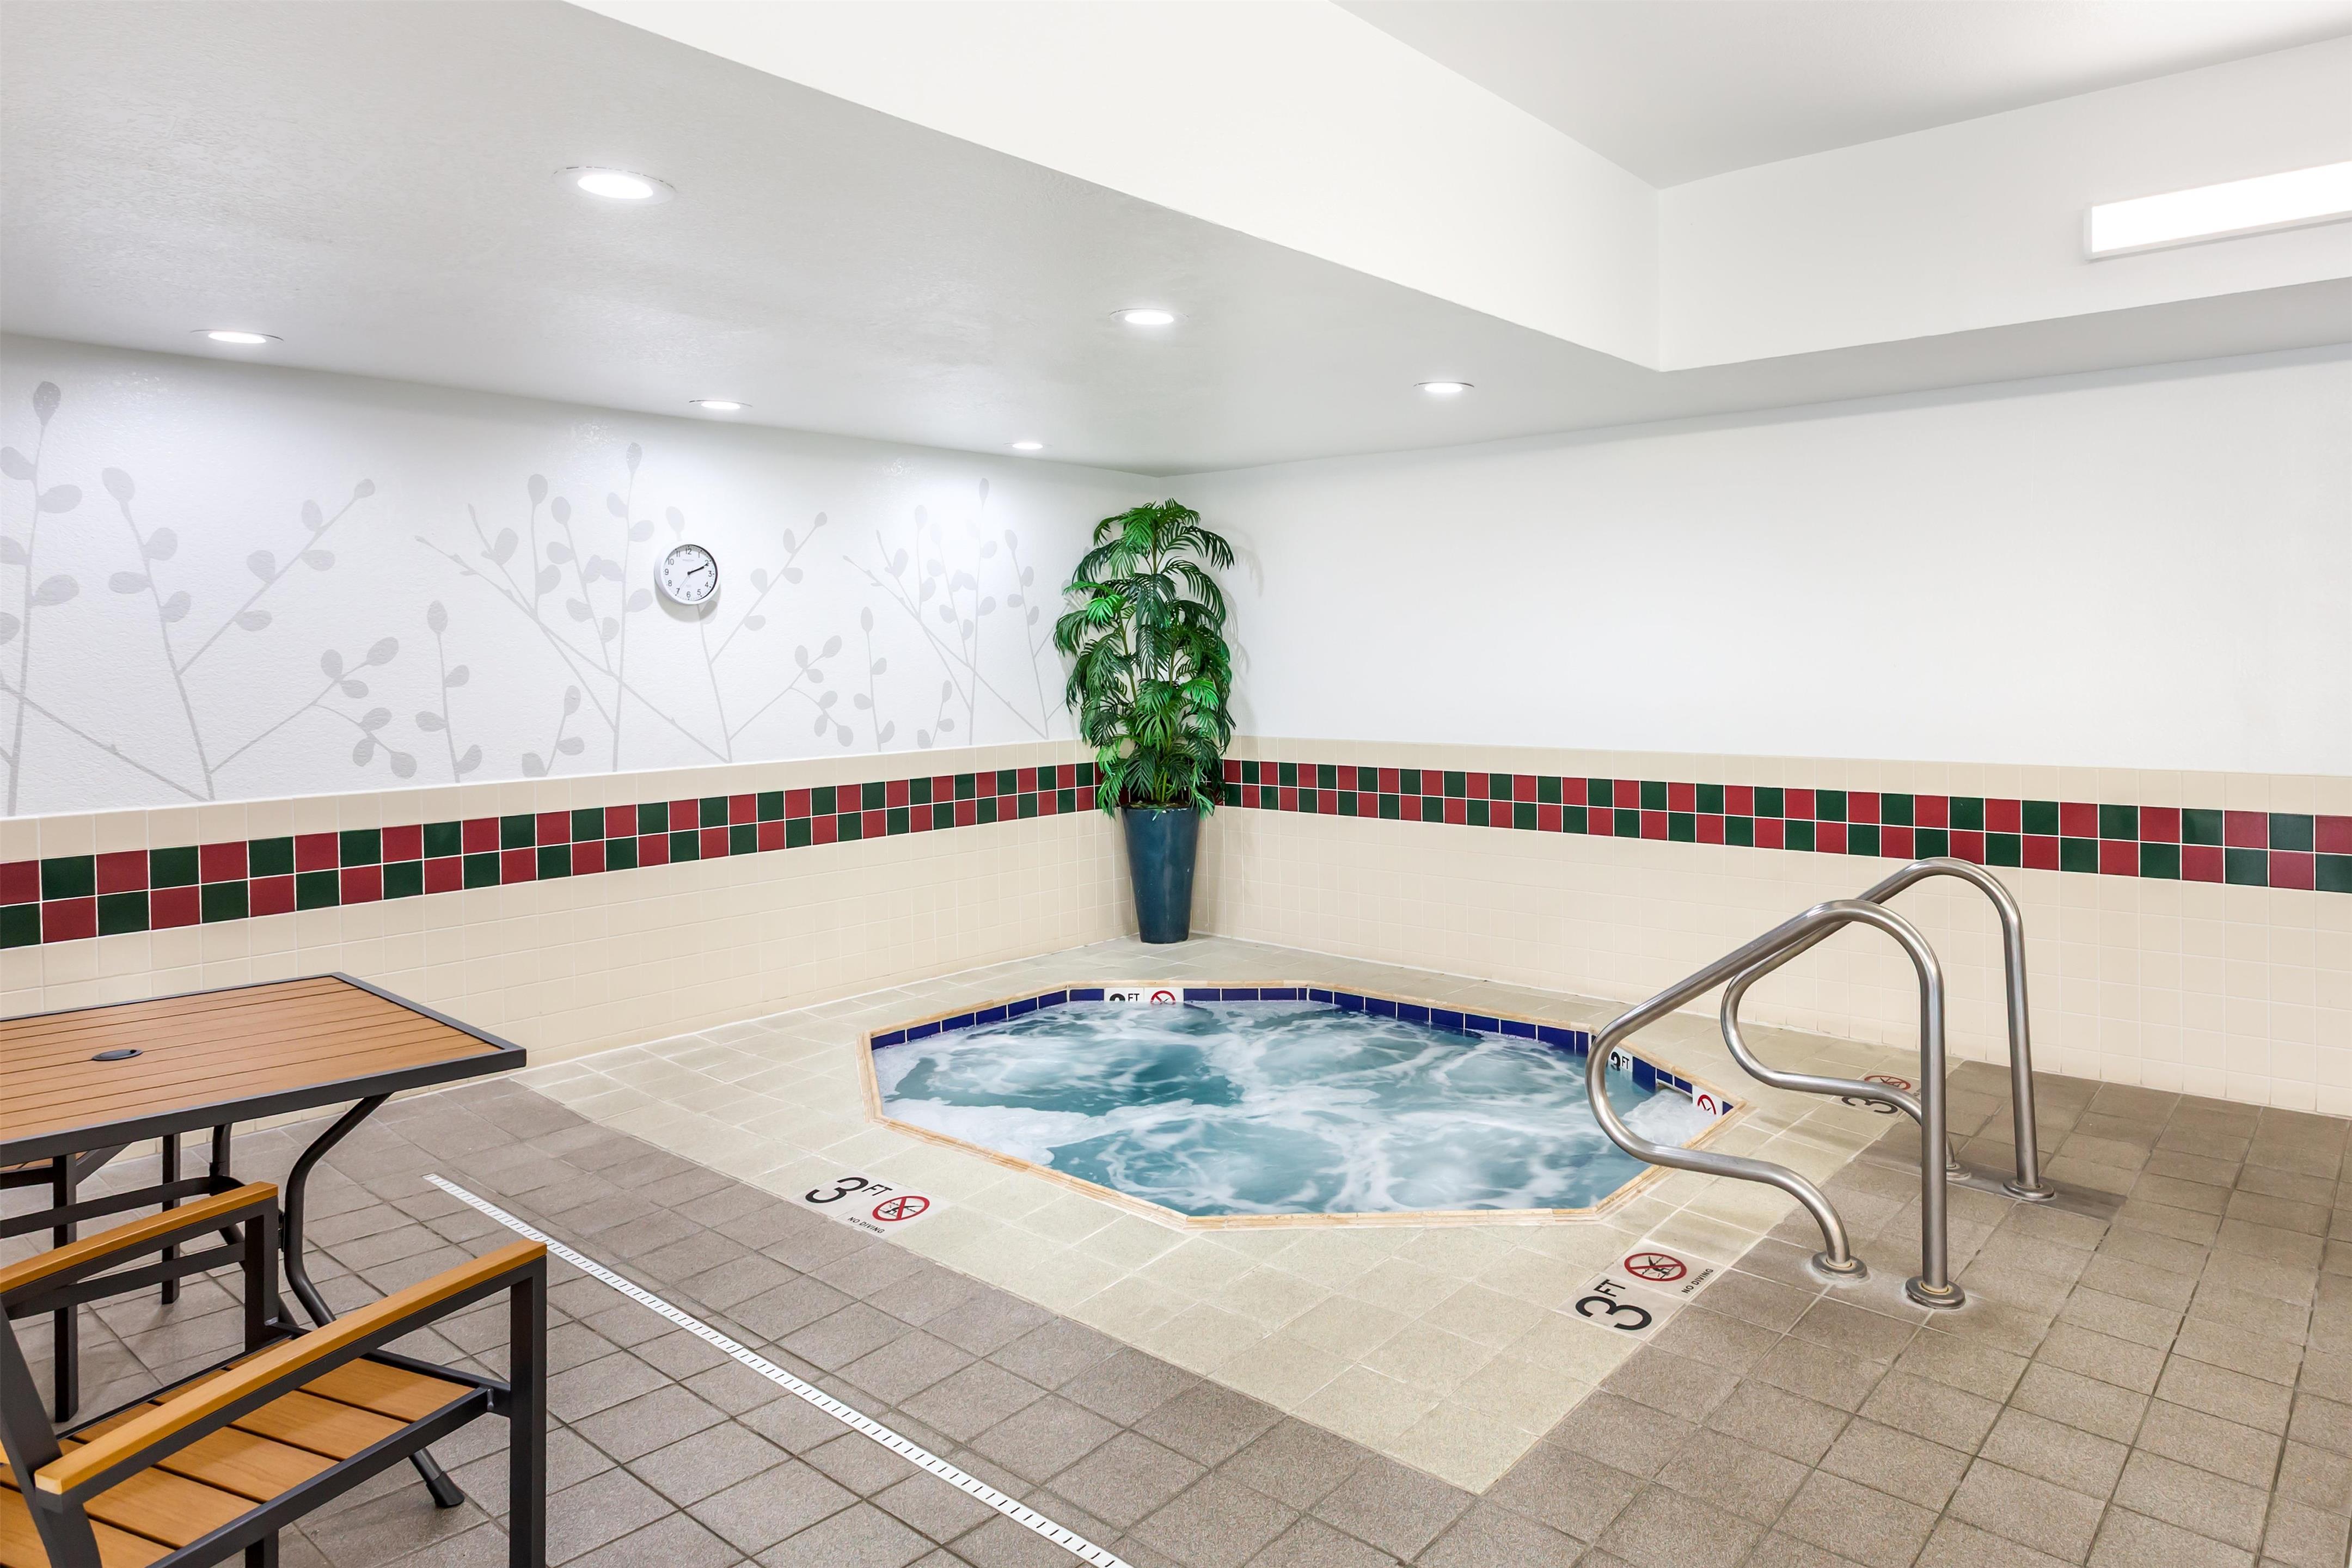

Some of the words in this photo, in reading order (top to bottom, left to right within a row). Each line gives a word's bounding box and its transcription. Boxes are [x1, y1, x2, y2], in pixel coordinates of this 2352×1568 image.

[1128, 993, 1140, 1001] FT
[1622, 1056, 1630, 1070] FT
[1841, 1097, 1898, 1114] 3
[805, 1177, 869, 1203] 3
[861, 1184, 893, 1196] FT
[859, 1221, 885, 1234] DIVING
[1593, 1278, 1626, 1297] FT
[1681, 1285, 1694, 1294] NO
[1690, 1268, 1714, 1285] DIVING
[1575, 1295, 1652, 1331] 3
